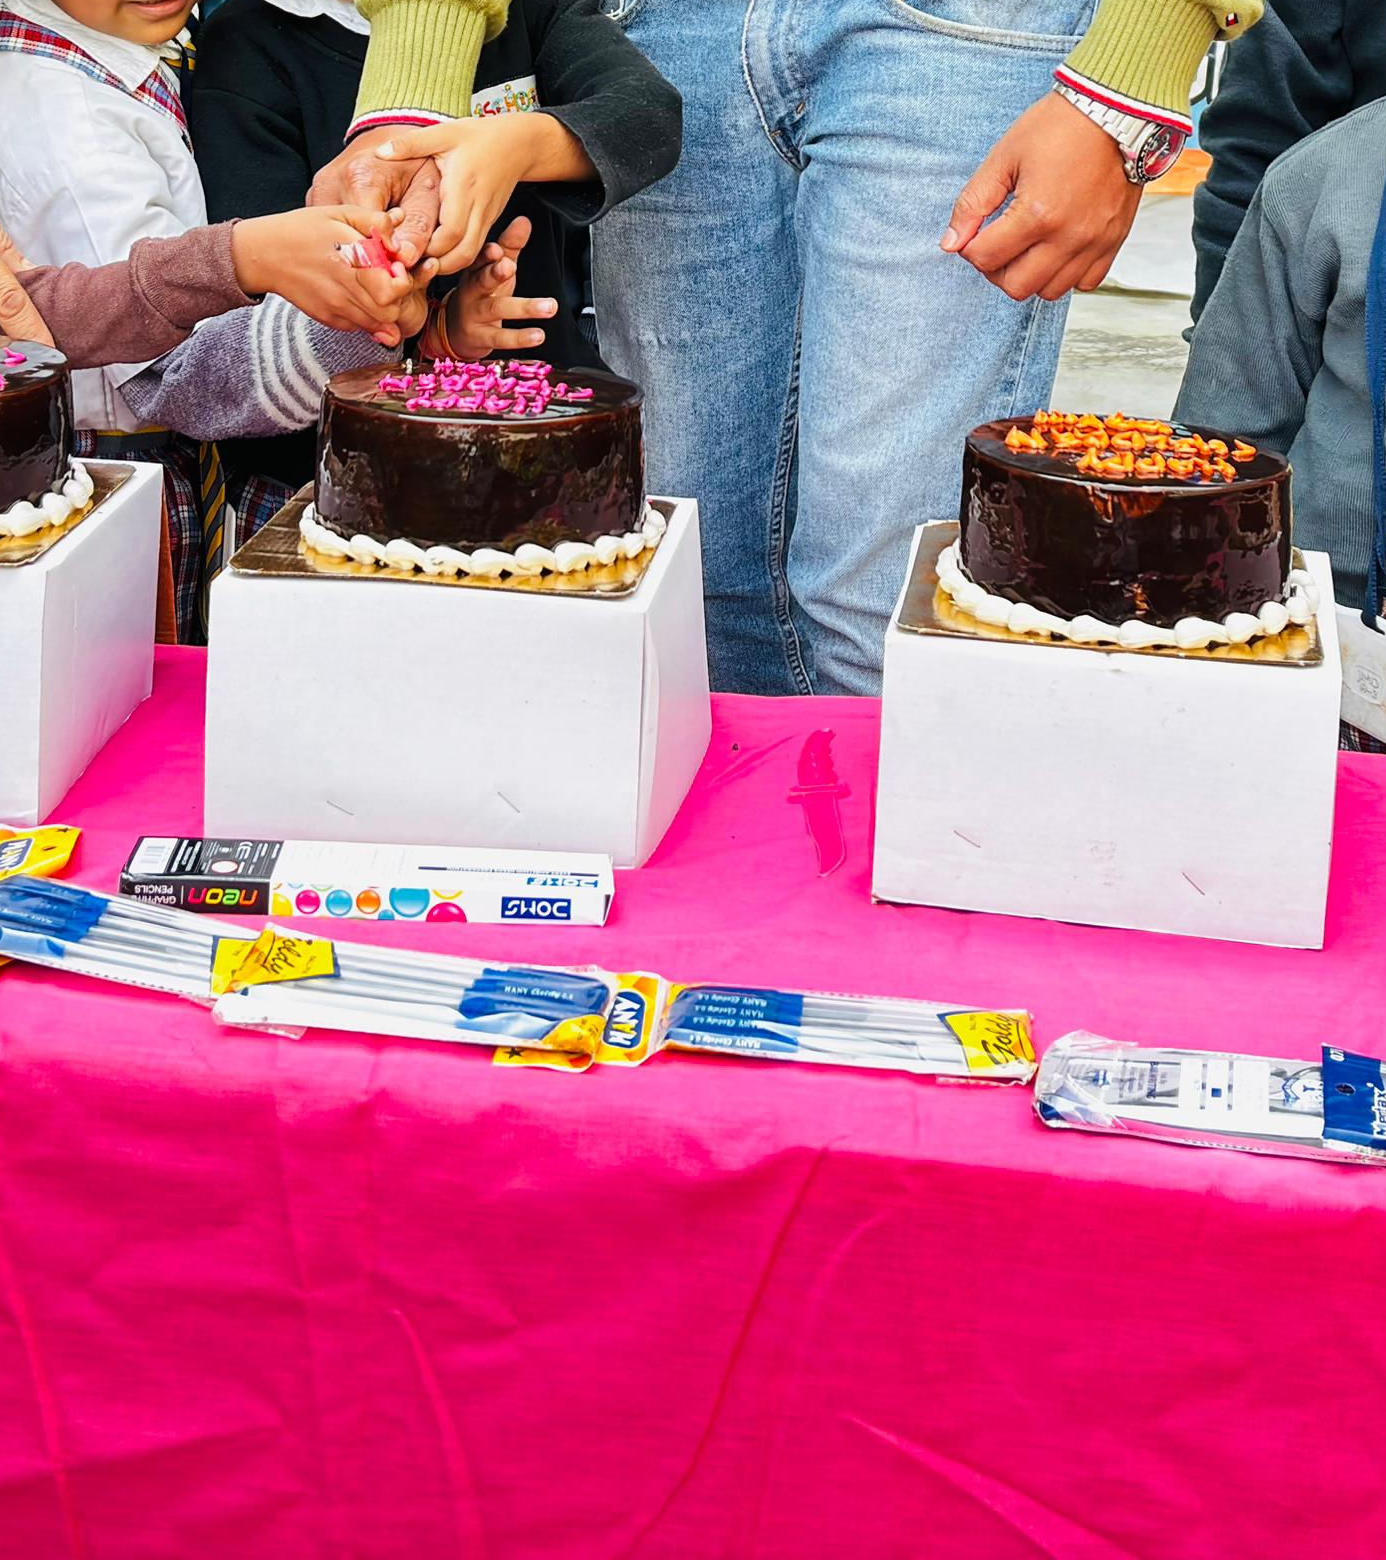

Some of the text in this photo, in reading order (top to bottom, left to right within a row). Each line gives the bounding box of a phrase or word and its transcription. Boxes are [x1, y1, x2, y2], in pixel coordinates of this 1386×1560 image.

[134, 884, 174, 894] PENCILS
[187, 887, 259, 907] neon
[504, 899, 569, 918] DOMS
[980, 1013, 1024, 1066] Goldy
